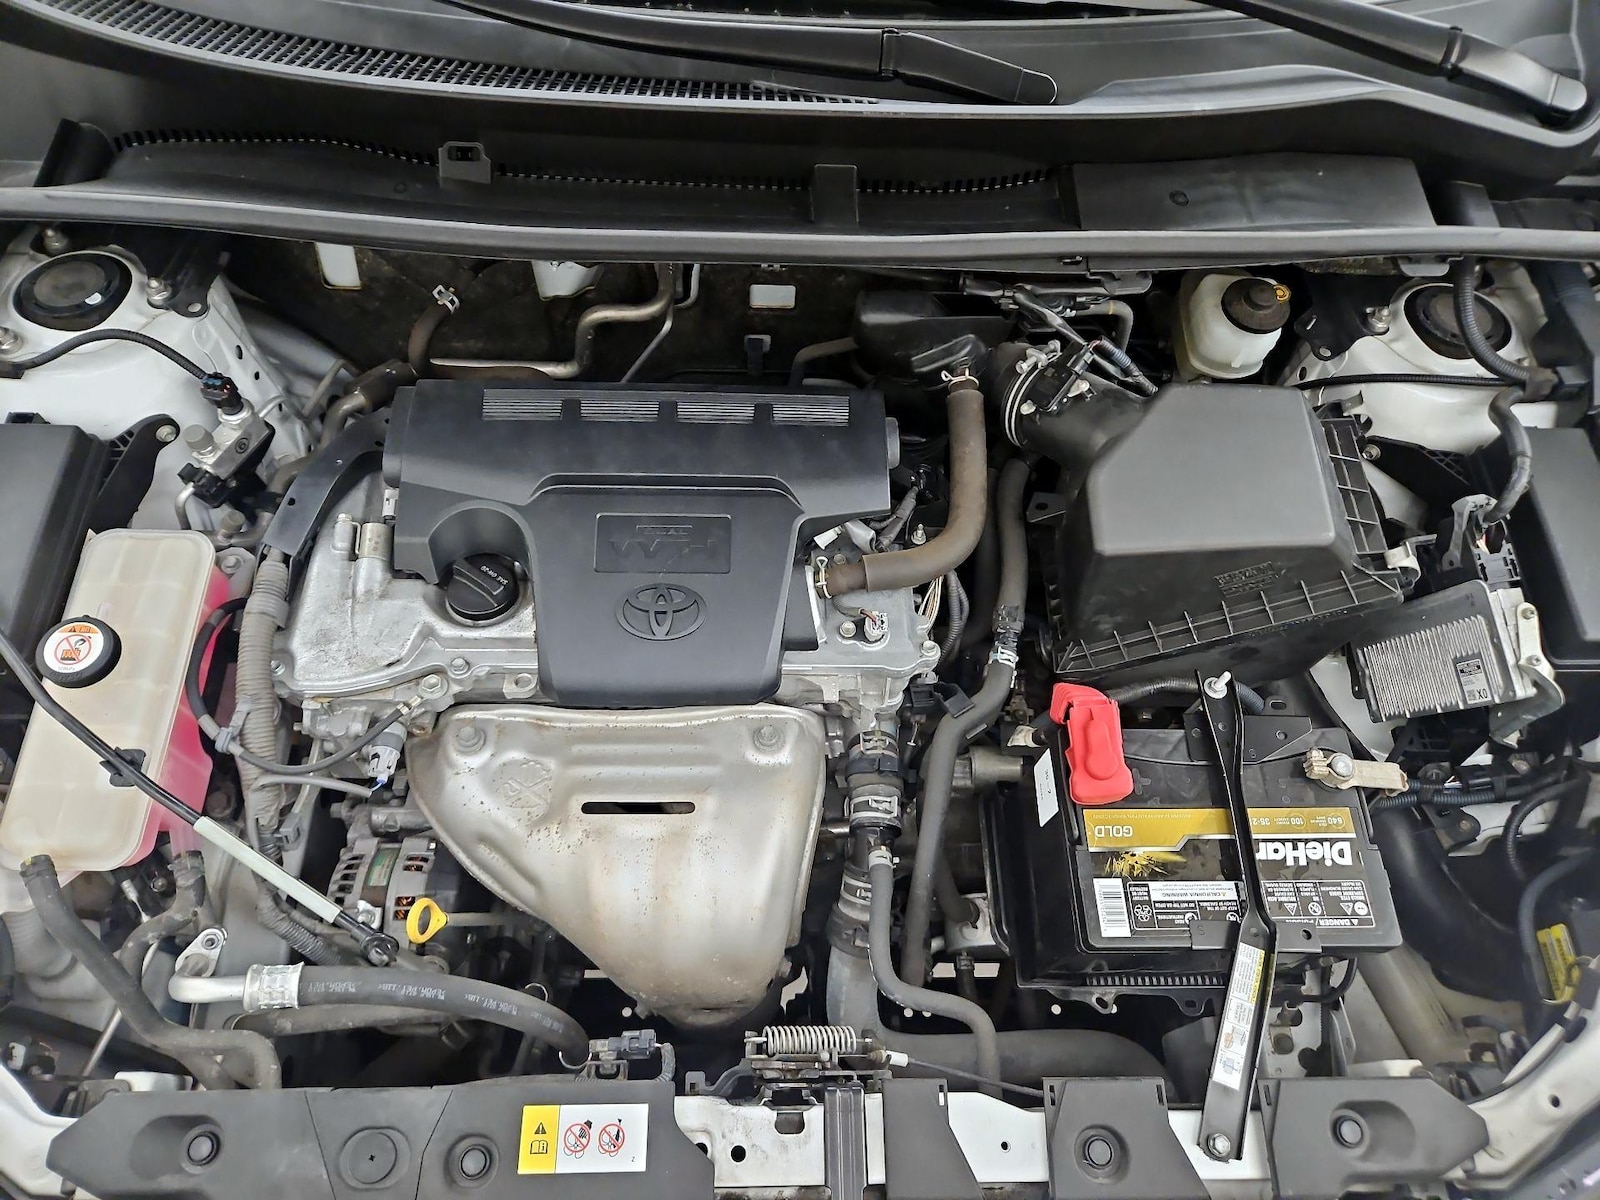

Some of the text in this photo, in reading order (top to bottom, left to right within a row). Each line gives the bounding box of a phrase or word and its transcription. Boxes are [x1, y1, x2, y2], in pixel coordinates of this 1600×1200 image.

[480, 565, 509, 585] SAE 0W-20
[1290, 817, 1304, 825] 100
[1094, 825, 1133, 838] GOLD
[1254, 840, 1353, 866] DieHar
[1318, 918, 1350, 926] DANGER
